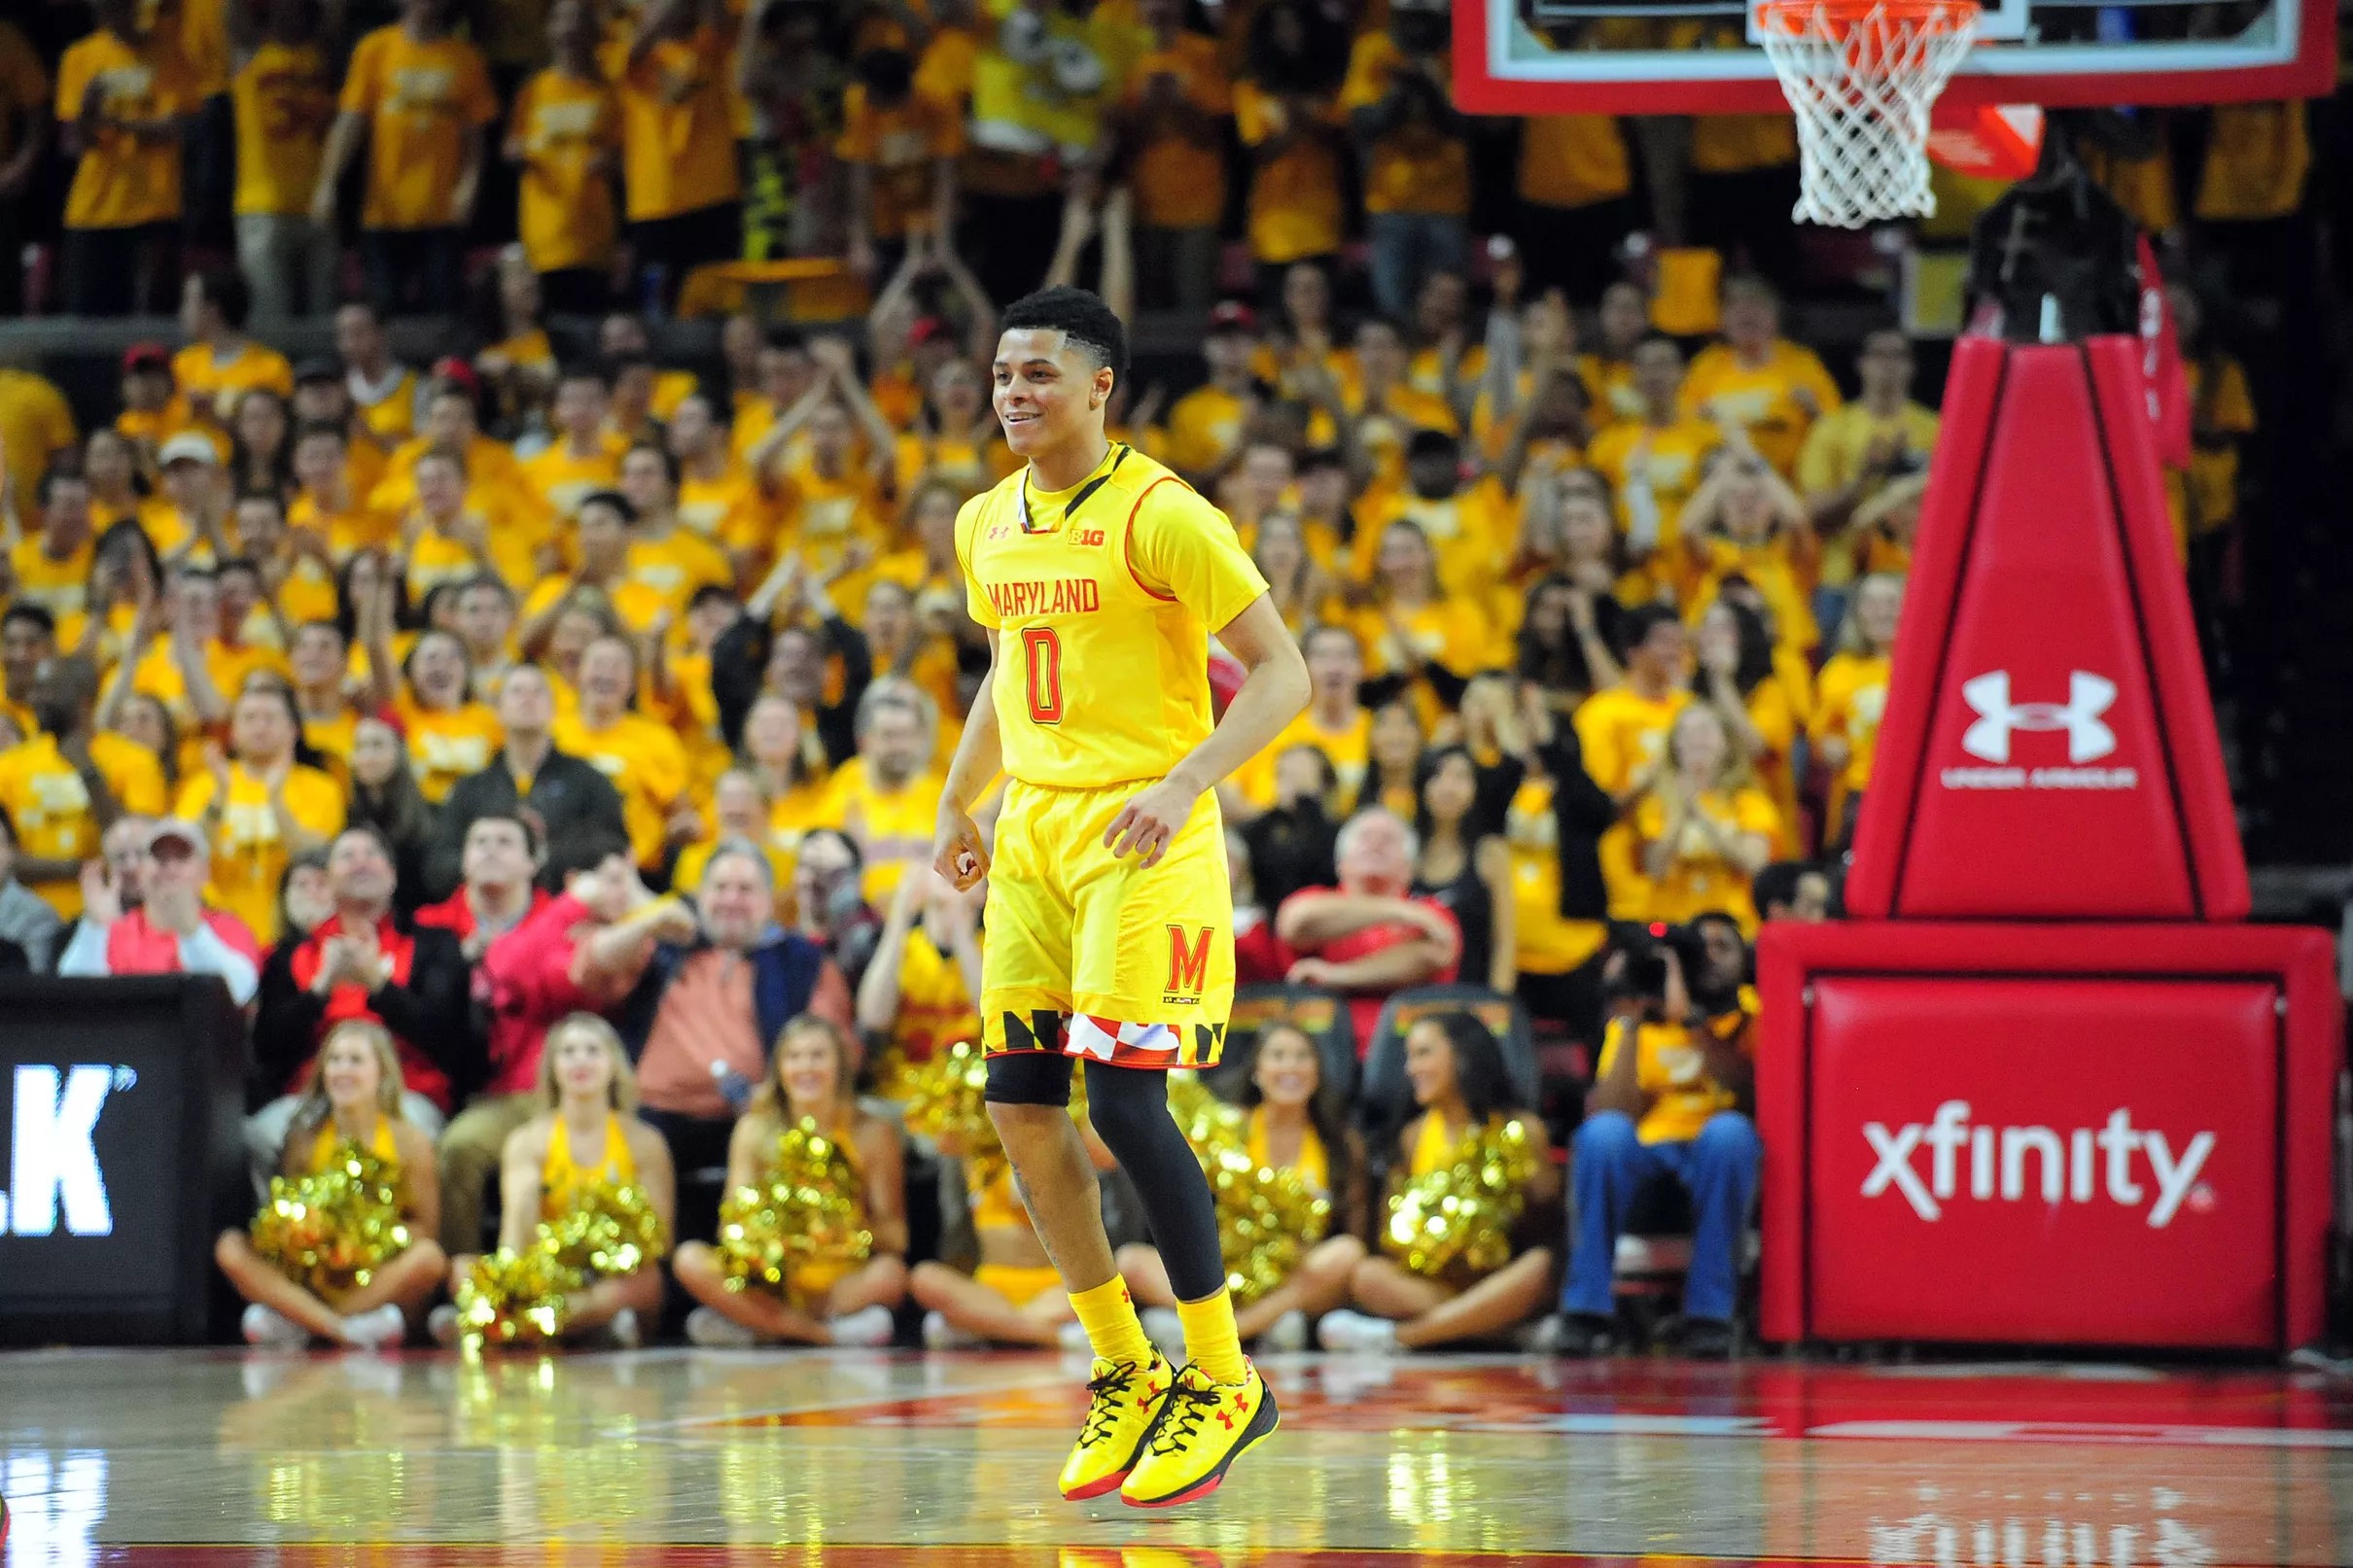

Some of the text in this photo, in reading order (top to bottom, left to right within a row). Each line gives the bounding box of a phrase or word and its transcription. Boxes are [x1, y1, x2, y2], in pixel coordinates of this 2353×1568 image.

[986, 578, 1100, 617] MARYLAND
[1022, 627, 1063, 724] 0
[1164, 923, 1214, 994] M
[0, 1063, 114, 1237] K
[1861, 1099, 2218, 1229] xfinity
